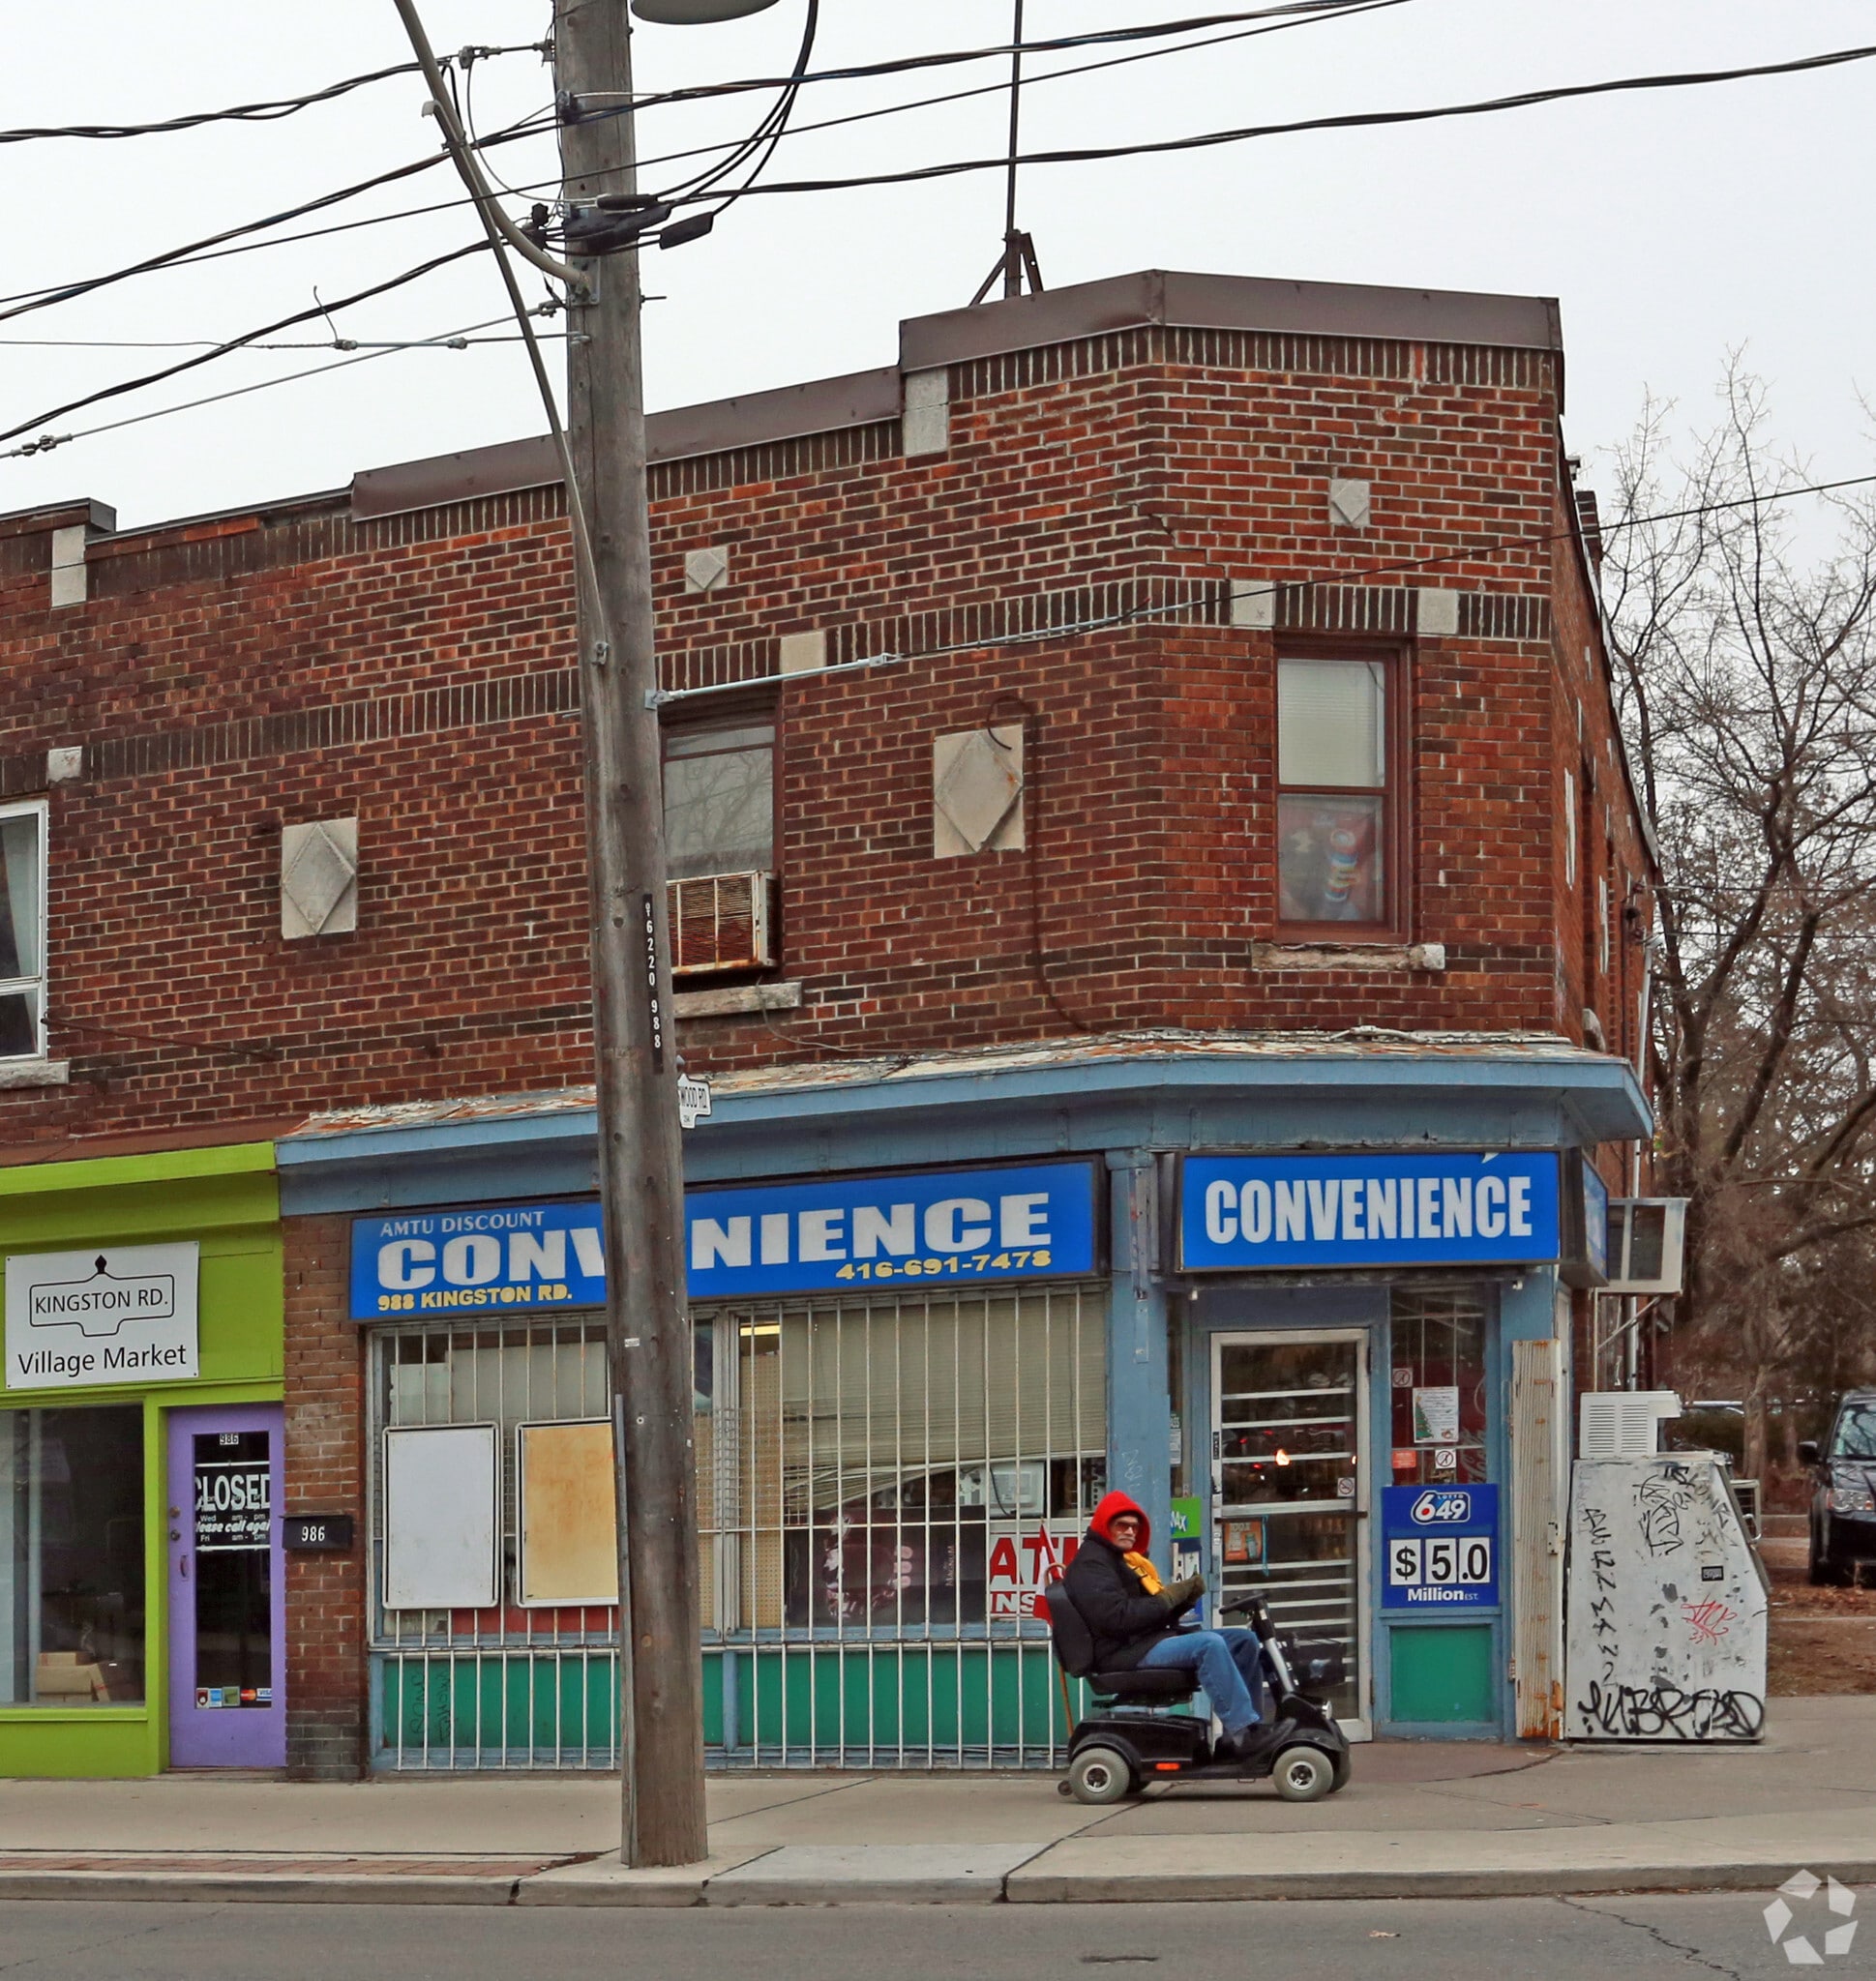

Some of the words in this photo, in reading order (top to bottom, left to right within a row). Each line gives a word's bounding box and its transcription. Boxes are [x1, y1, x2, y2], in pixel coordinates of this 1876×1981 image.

[380, 1219, 434, 1237] AMTU
[441, 1210, 546, 1232] DISCOUNT
[1205, 1175, 1533, 1245] CONVENIENCE
[377, 1192, 1052, 1290] CONVNIENCE
[835, 1250, 1052, 1281] 416-691-7478
[36, 1290, 131, 1314] KINGSTON
[138, 1288, 168, 1306] RD.
[377, 1292, 415, 1311] 988
[421, 1286, 531, 1308] KINGSTON
[538, 1284, 573, 1301] RD.
[18, 1350, 95, 1377] Village
[104, 1344, 187, 1370] Market
[220, 1434, 239, 1445] 986
[195, 1521, 223, 1532] lease
[246, 1520, 271, 1535] agai
[301, 1525, 326, 1542] 986
[1408, 1587, 1464, 1602] Million
